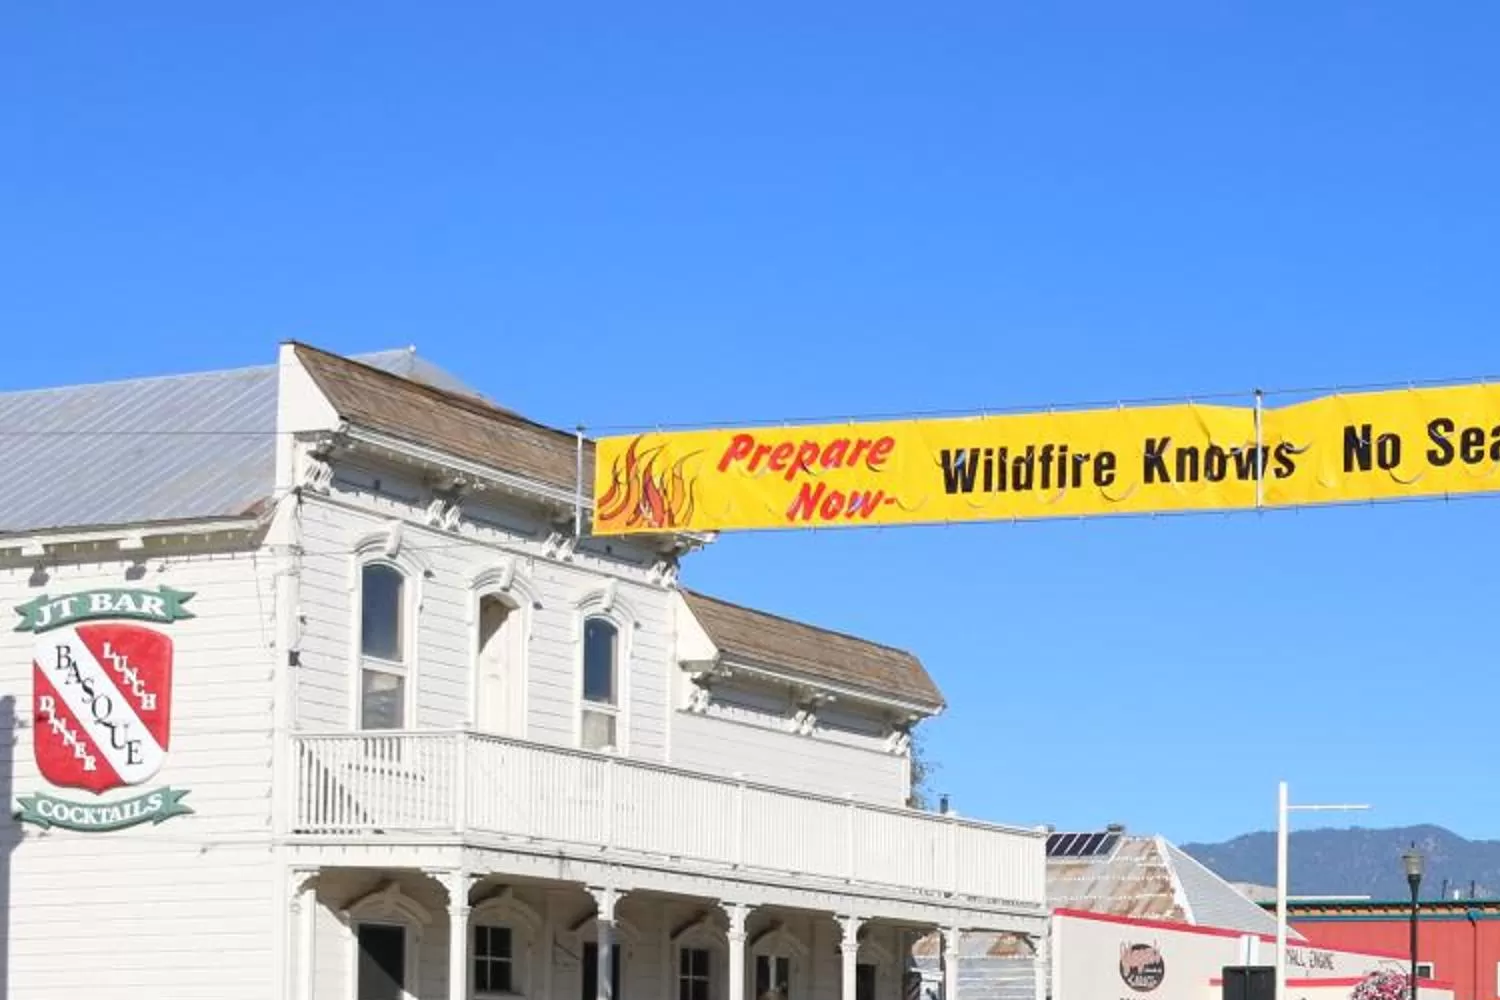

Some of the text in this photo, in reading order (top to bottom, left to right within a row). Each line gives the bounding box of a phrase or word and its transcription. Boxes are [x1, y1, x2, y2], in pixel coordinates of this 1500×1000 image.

[716, 433, 895, 482] Prepare
[940, 436, 1297, 495] Wildfire Knows
[1343, 423, 1401, 473] No
[37, 593, 165, 627] JT BAR
[103, 642, 156, 710] LUNCH
[56, 646, 143, 765] BASQUE
[40, 696, 97, 771] DINNER
[36, 793, 163, 824] COCKTAILS
